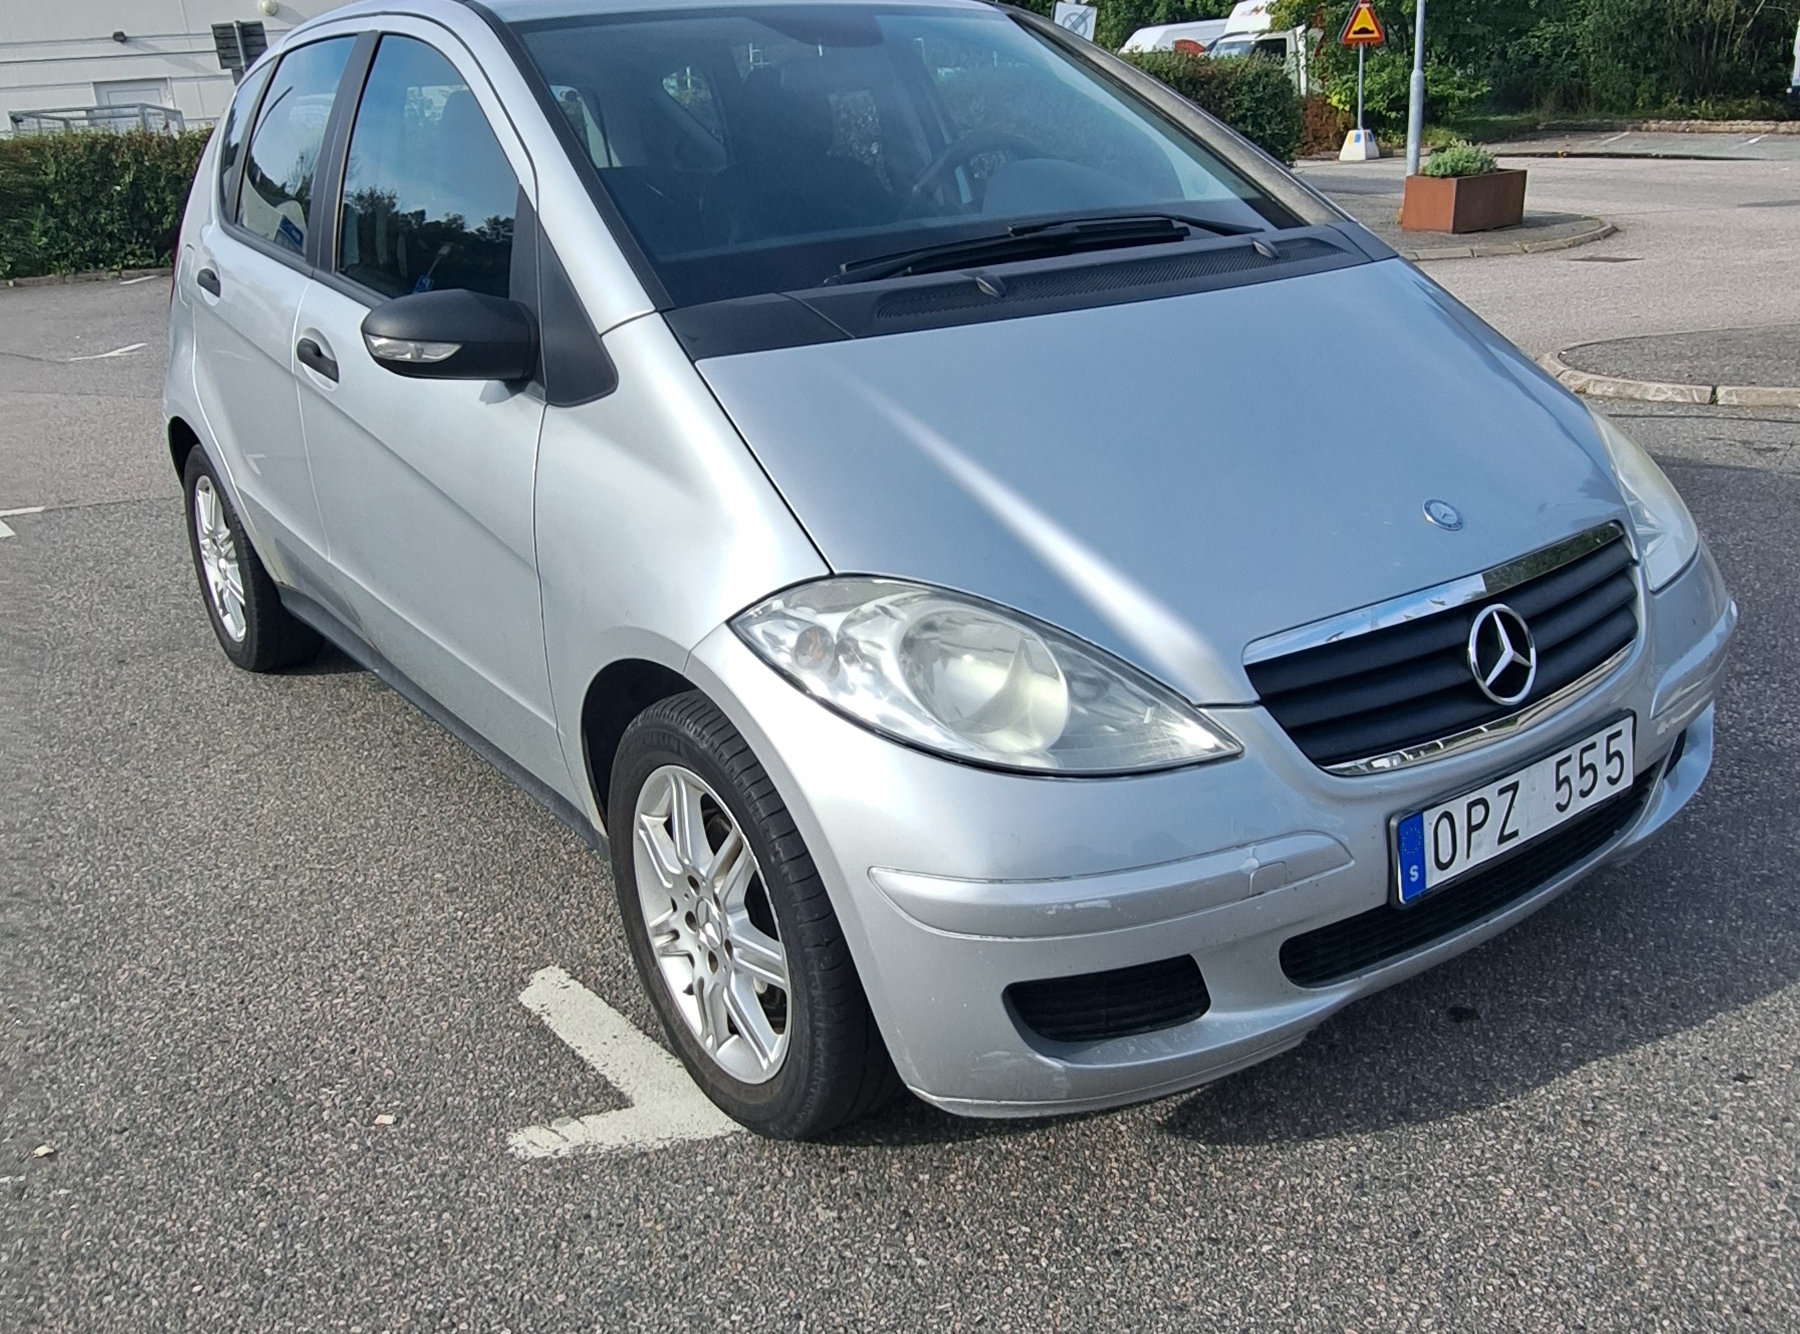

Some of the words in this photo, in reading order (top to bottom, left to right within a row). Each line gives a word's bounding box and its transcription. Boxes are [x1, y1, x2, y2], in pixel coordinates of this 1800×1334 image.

[1433, 780, 1520, 871] OPZ
[1555, 729, 1625, 813] 555
[1409, 865, 1419, 882] S
